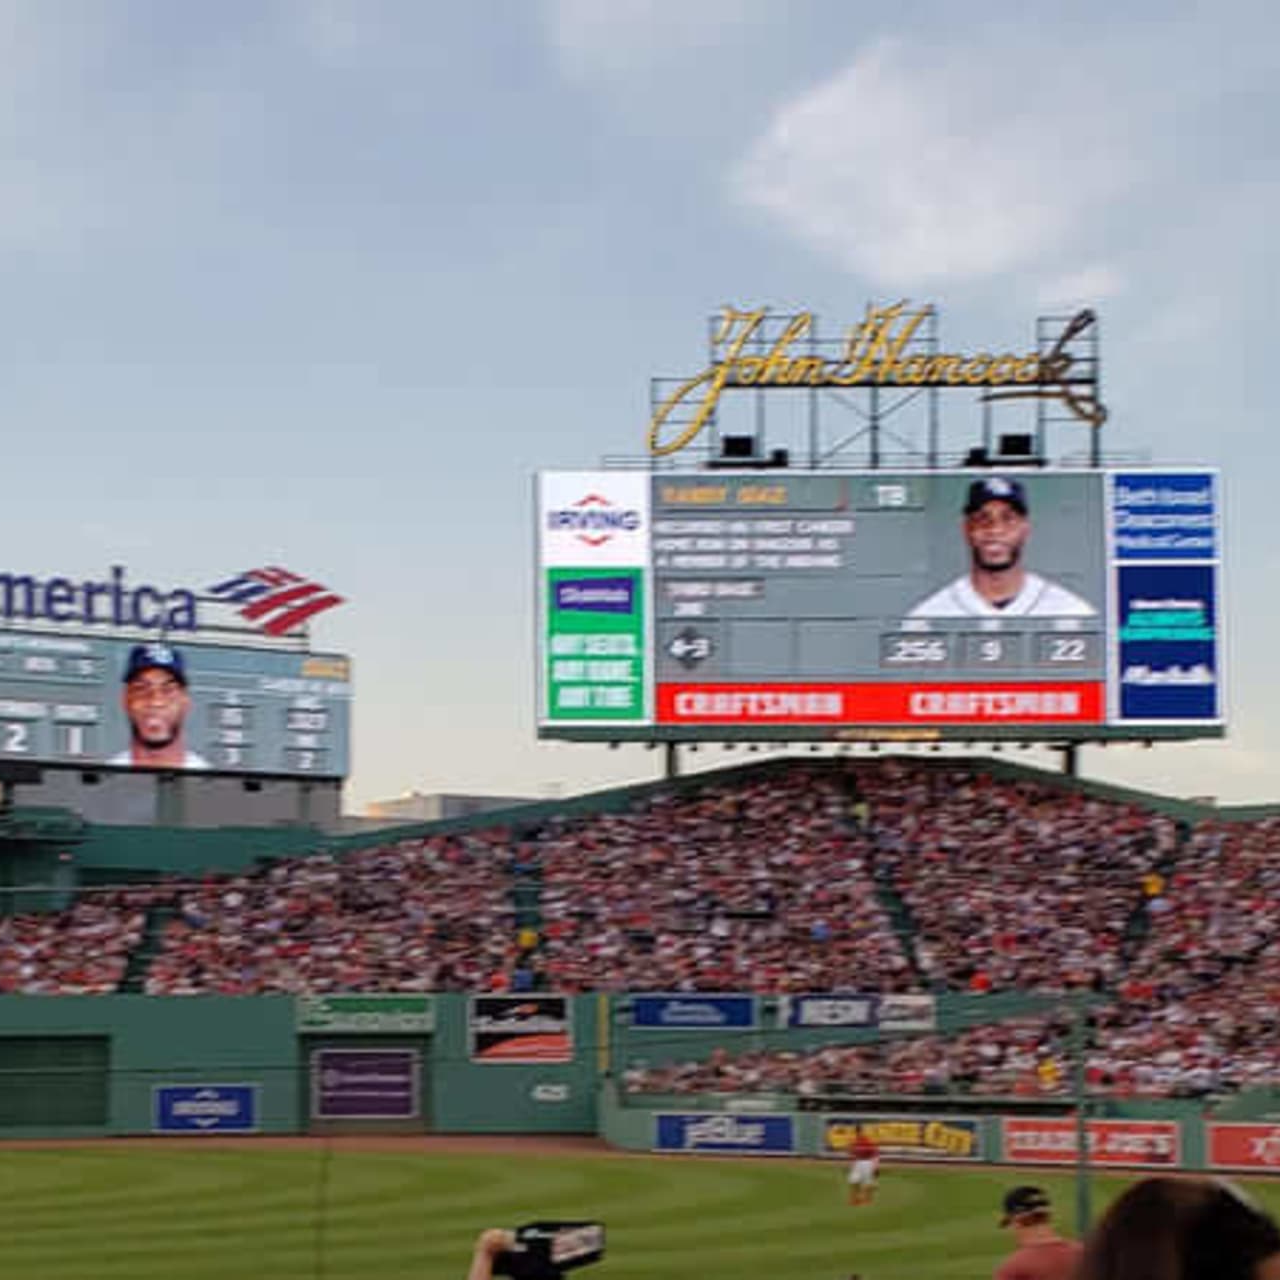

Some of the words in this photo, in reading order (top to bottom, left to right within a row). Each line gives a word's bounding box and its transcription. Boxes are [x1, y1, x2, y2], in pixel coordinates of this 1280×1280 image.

[647, 299, 826, 455] John
[828, 299, 1108, 427] Hancock
[547, 510, 639, 531] IRVING
[979, 641, 1003, 661] 9
[1050, 640, 1086, 661] 22
[674, 692, 842, 716] CRAFTSMAN
[910, 692, 1081, 716] CRAFTSMAN
[3, 723, 30, 752] 2
